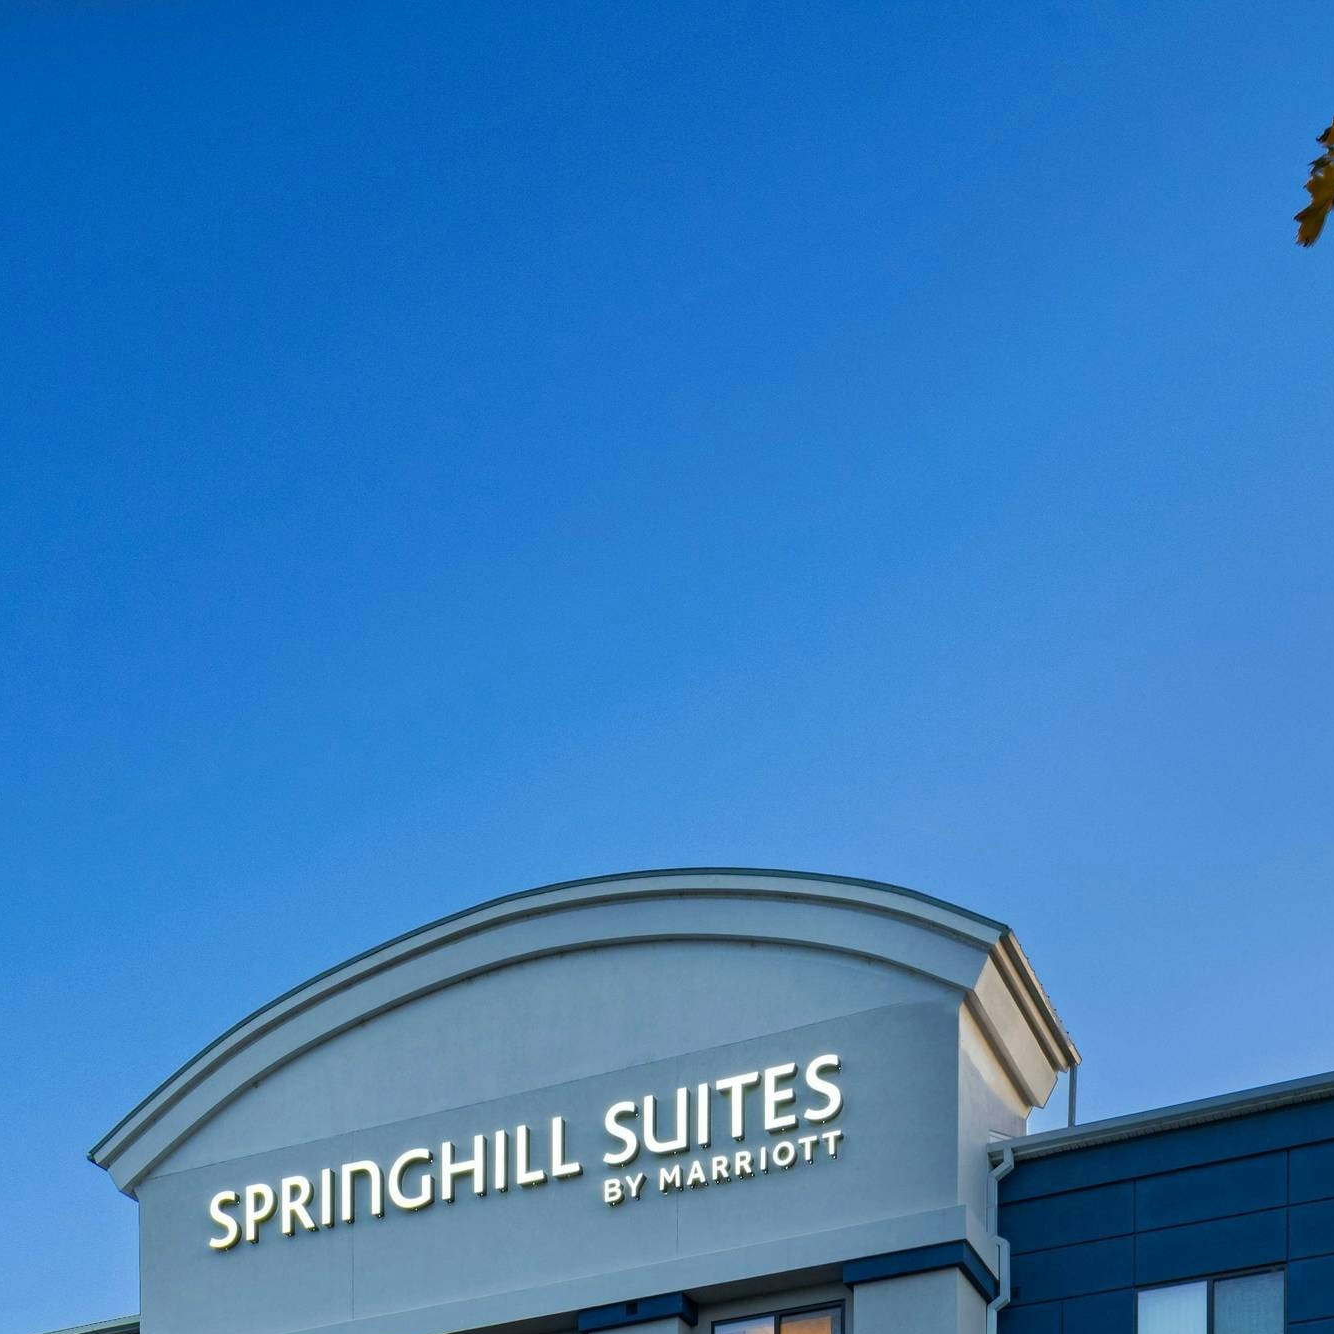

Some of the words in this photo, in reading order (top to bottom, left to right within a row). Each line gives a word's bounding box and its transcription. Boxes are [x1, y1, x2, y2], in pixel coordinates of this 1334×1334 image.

[208, 1116, 583, 1251] SPRINGHILL
[602, 1054, 843, 1167] SUITES
[603, 1172, 646, 1206] BY
[658, 1129, 844, 1196] MARRIOTT
